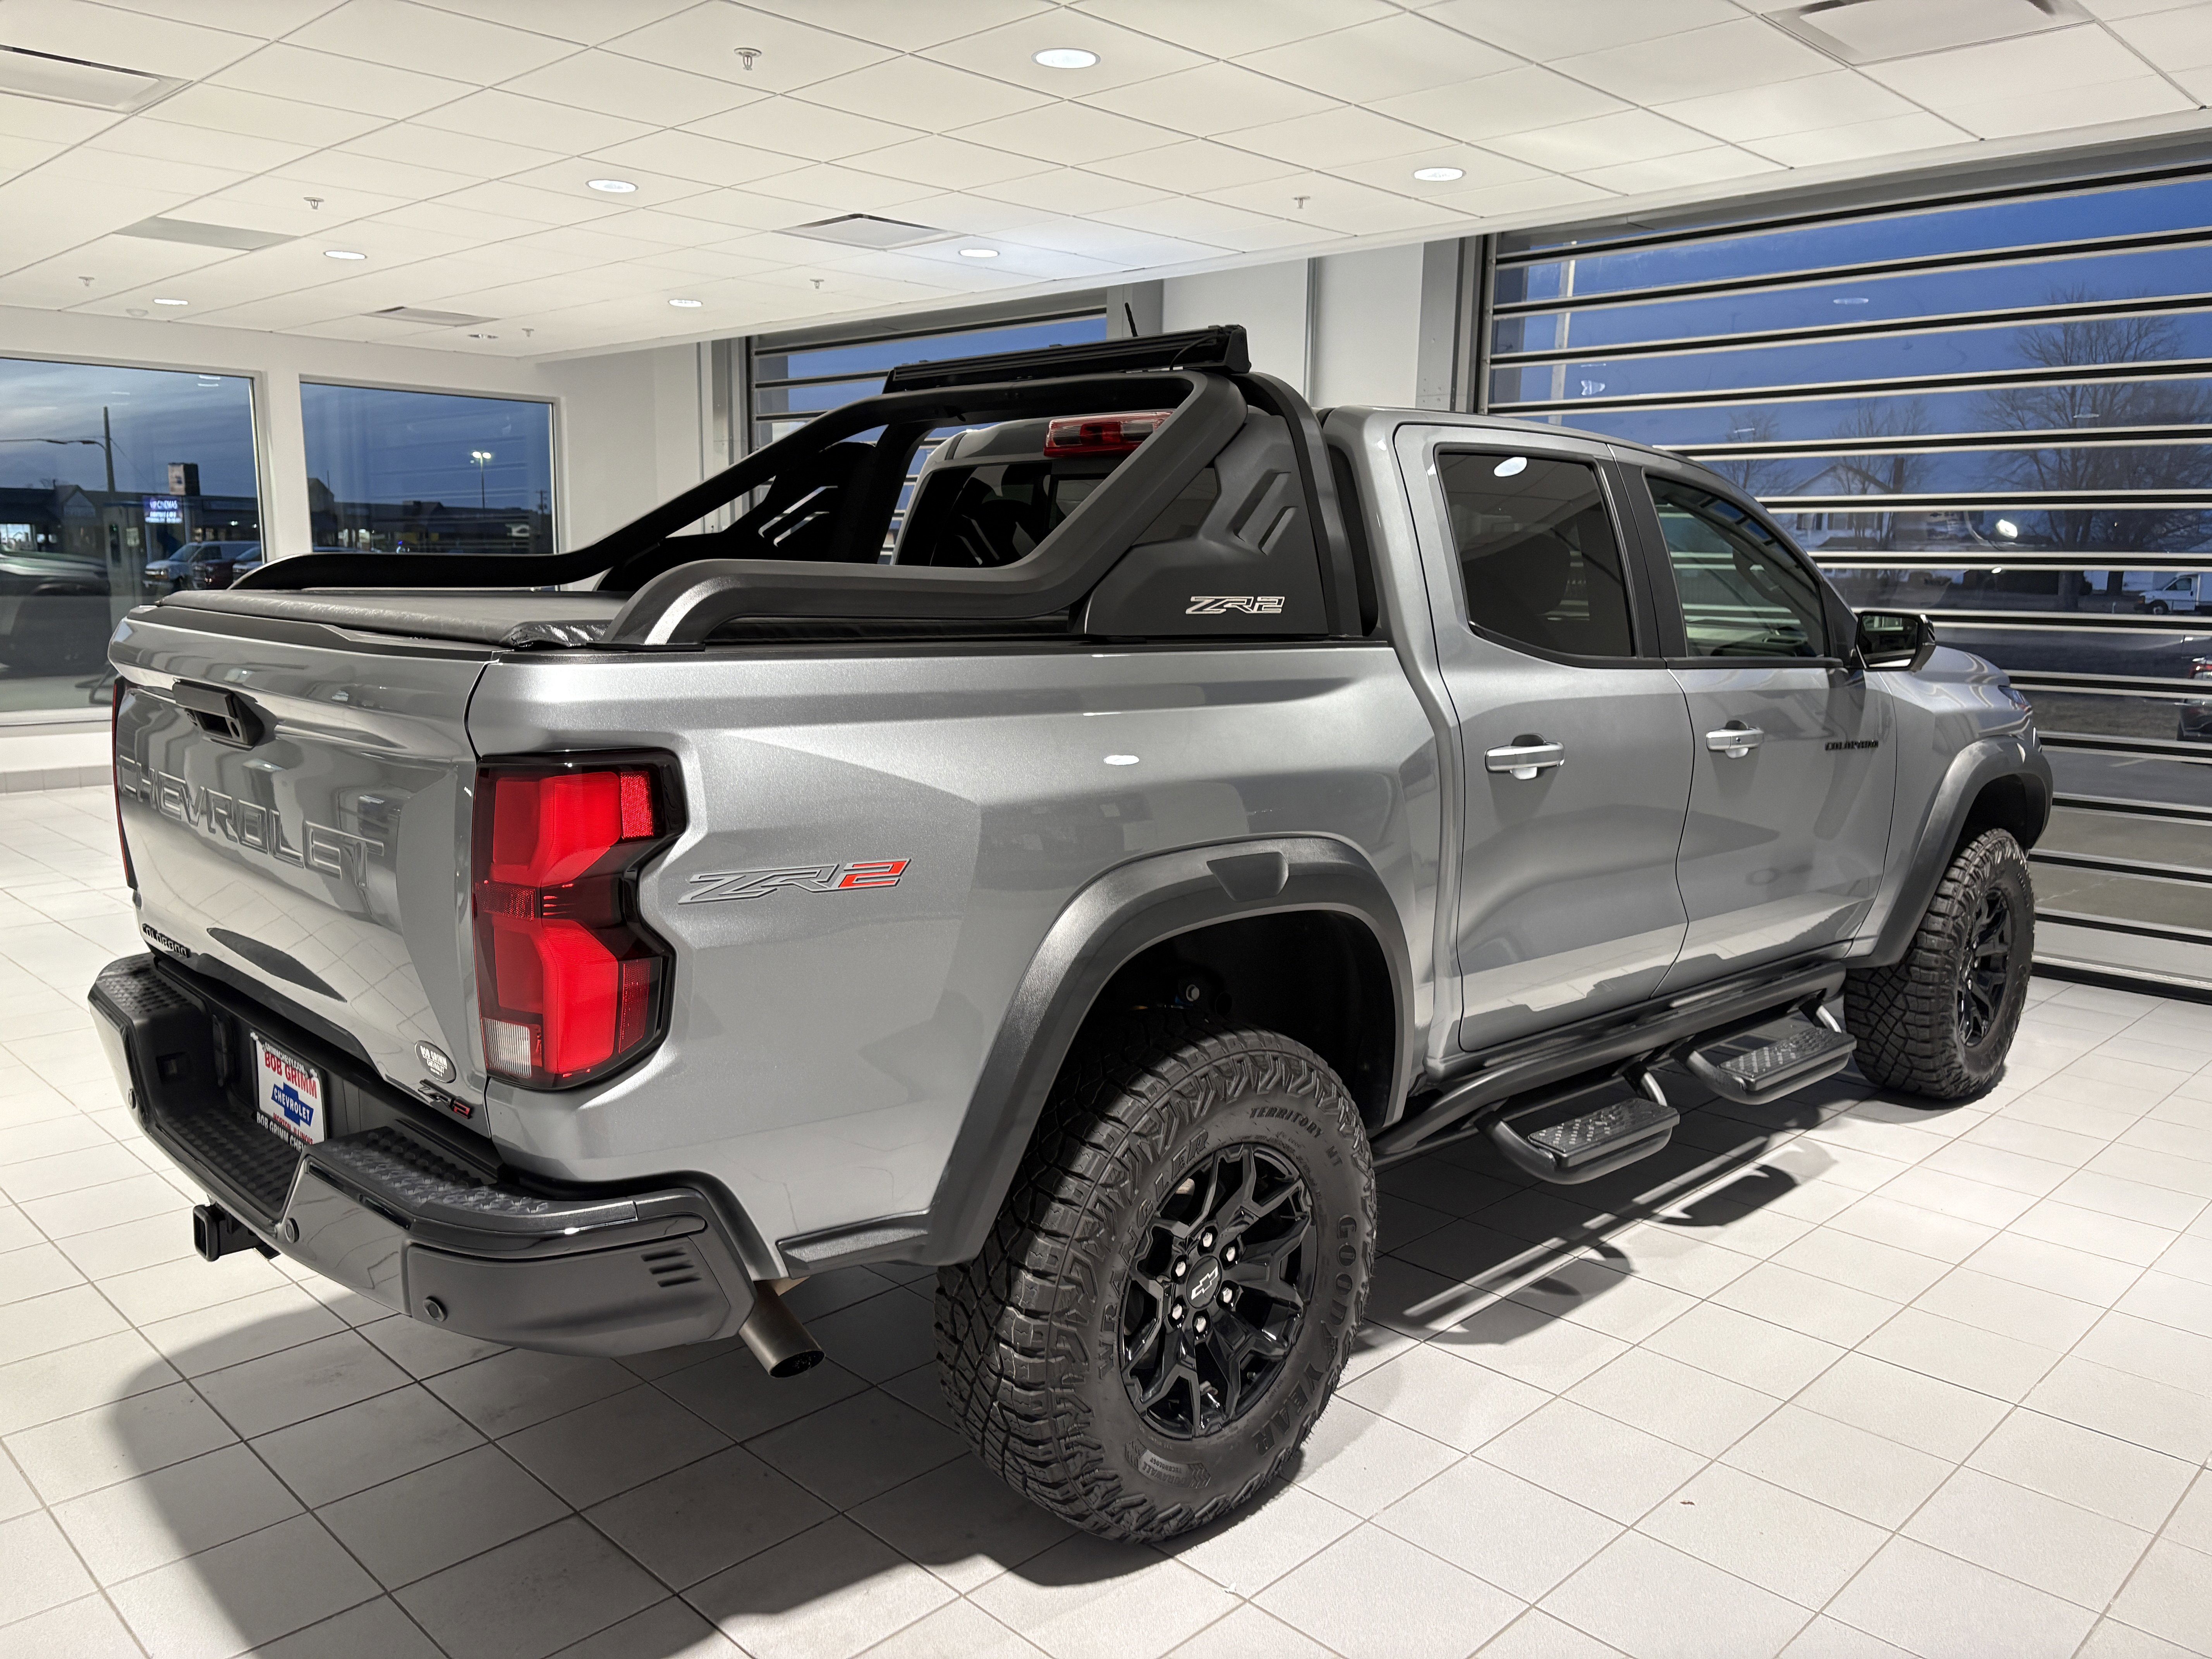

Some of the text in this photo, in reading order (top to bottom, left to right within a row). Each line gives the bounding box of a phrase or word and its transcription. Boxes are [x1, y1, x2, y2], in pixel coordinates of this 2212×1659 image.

[1185, 596, 1285, 615] ZR2
[1824, 740, 1879, 751] COLORADO
[118, 754, 385, 888] CHEVROLET
[677, 858, 912, 905] ZR2
[265, 1051, 317, 1099] BOB GRIMM
[431, 1051, 447, 1068] GRIMM
[274, 1087, 310, 1122] CHEVROLET
[418, 1080, 472, 1120] ZR2
[256, 1111, 268, 1129] BOB
[270, 1120, 289, 1144] GRIMM
[1249, 1106, 1324, 1138] TERRITORY
[1325, 1145, 1343, 1166] MT
[1098, 1128, 1209, 1380] WRANGLER
[1150, 1457, 1182, 1474] TECHNOLOGY
